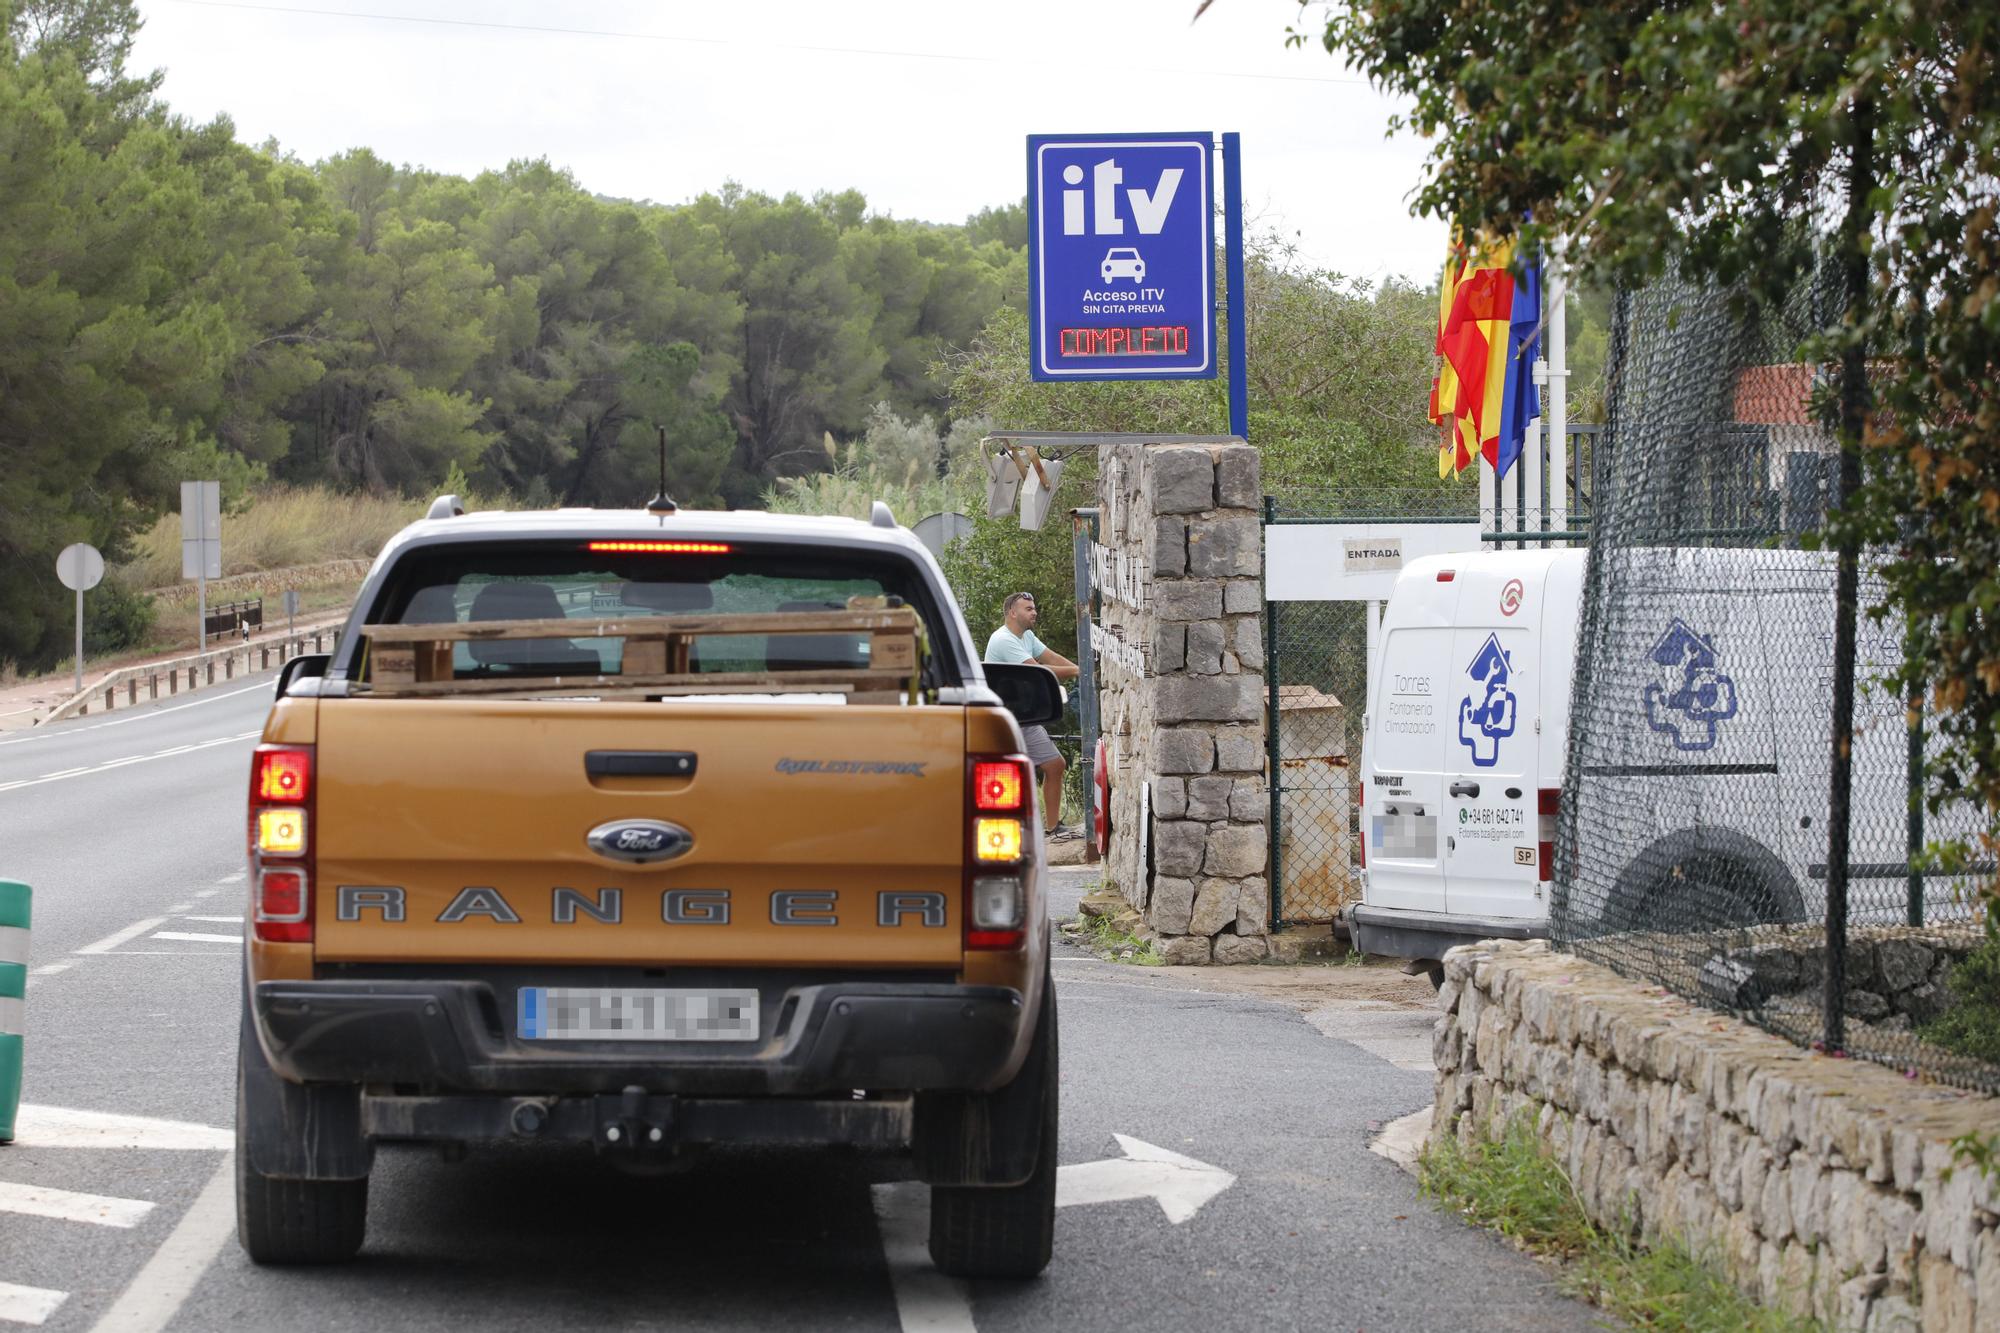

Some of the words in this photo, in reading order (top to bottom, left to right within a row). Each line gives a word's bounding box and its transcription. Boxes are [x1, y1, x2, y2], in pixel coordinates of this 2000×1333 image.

[1063, 158, 1184, 235] itv
[1083, 289, 1137, 301] Acceso
[1141, 288, 1165, 301] ITV
[1083, 305, 1100, 314] SIN
[1102, 305, 1126, 314] CITA
[1128, 304, 1165, 313] PREVIA
[1060, 326, 1188, 355] COMPLETO
[1347, 549, 1400, 559] ENTRADA
[1394, 674, 1431, 692] Torres
[1469, 809, 1480, 824] +34
[1482, 809, 1494, 824] 661
[1496, 809, 1509, 824] 642
[1511, 809, 1524, 824] 741
[617, 829, 661, 849] Ford
[1518, 850, 1532, 861] SP
[336, 885, 947, 927] RANGER
